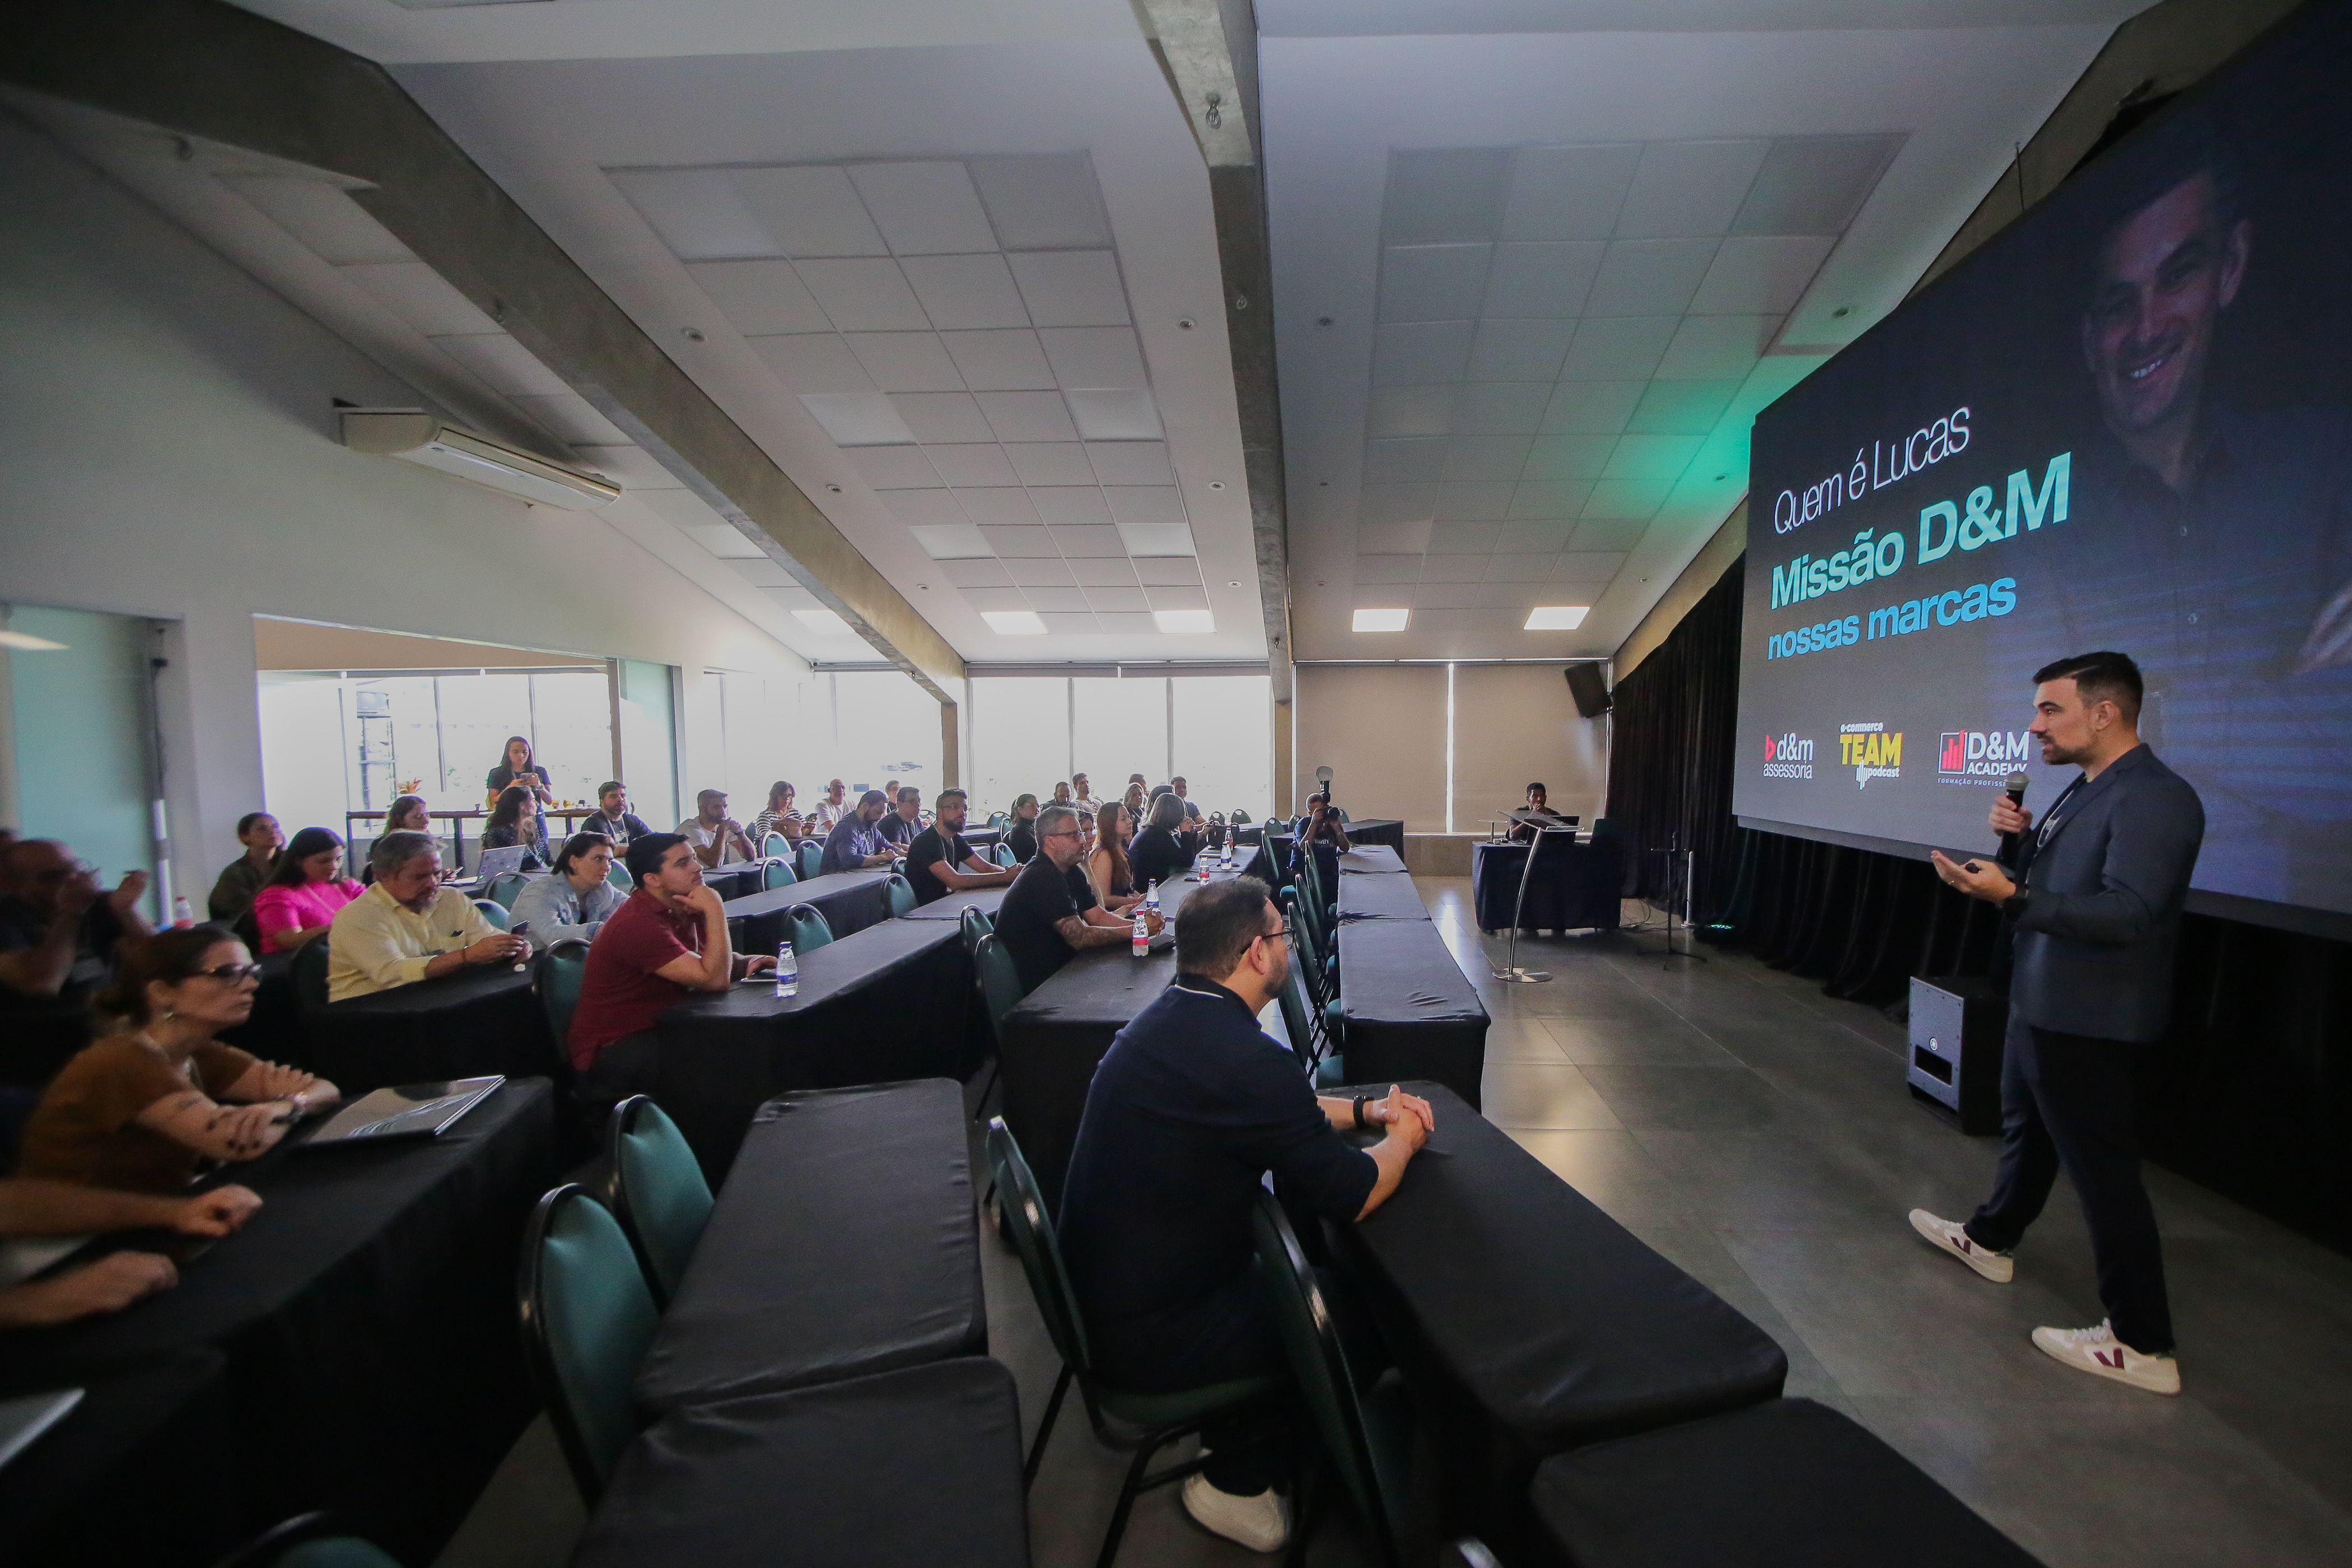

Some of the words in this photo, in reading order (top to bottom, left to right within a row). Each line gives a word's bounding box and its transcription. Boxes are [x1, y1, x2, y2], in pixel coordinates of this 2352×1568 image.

[1774, 472, 1842, 535] Quem
[1848, 447, 1866, 500] é
[1873, 406, 1971, 491] Lucas
[1770, 526, 1905, 610] Missão
[1917, 451, 2071, 565] D&M
[1767, 614, 1860, 660] nossas
[1867, 576, 2017, 641] marcas
[1776, 732, 1813, 761] d&m
[1840, 732, 1902, 767] TEAM
[1967, 731, 2031, 761] D&M
[1763, 762, 1813, 780] assessoria
[1868, 766, 1901, 778] podcast
[1938, 777, 1972, 786] FORMAÇÃO
